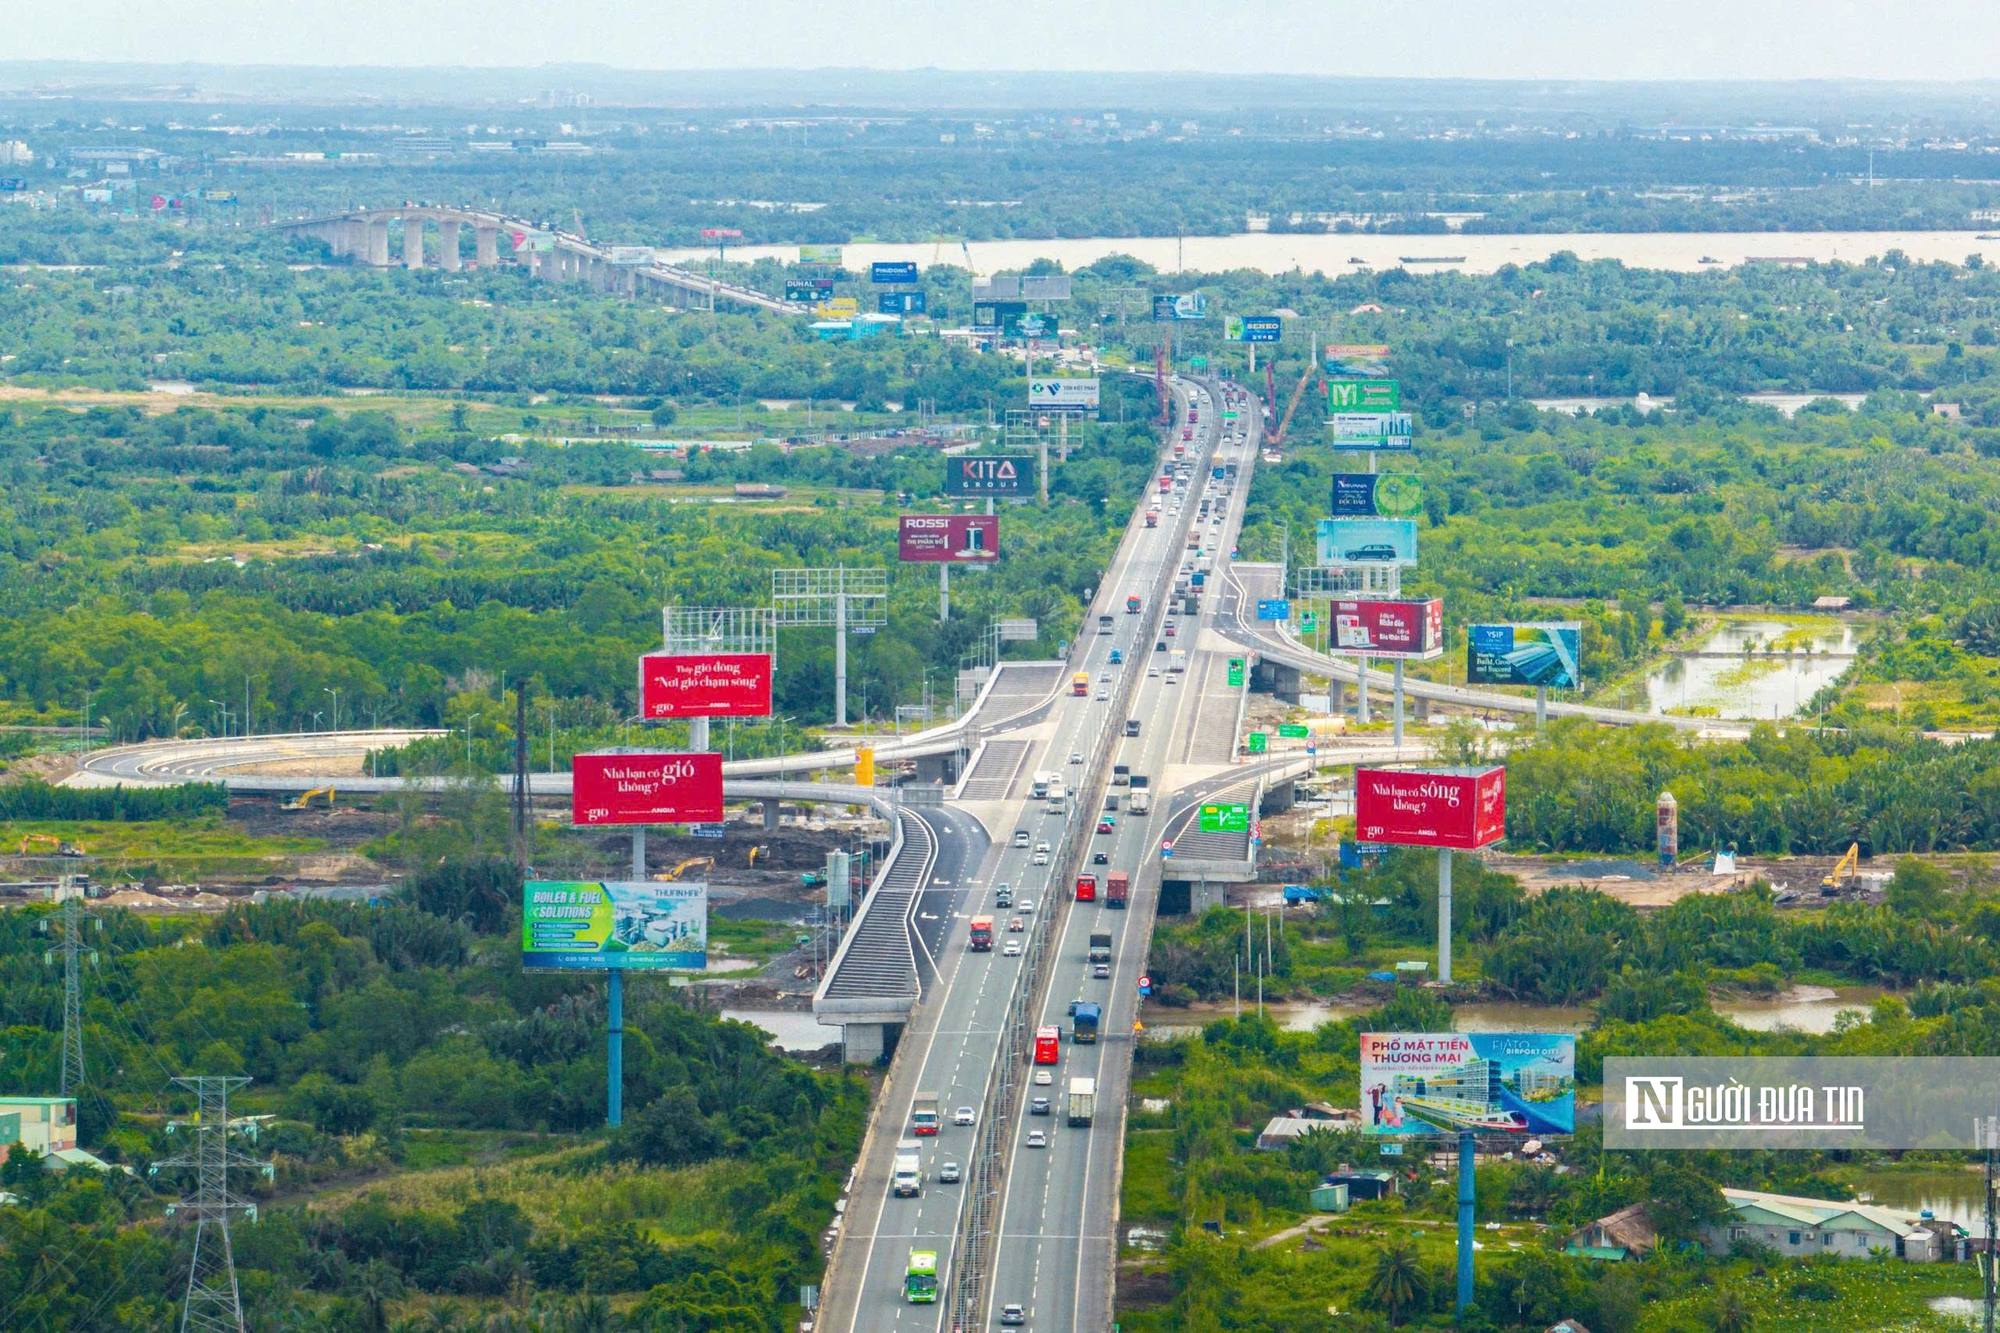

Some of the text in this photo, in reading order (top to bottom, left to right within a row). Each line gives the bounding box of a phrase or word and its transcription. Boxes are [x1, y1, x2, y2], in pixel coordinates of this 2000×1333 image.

[787, 280, 815, 288] DUHAL
[963, 460, 1017, 479] KITA
[906, 519, 949, 528] ROSSI
[944, 534, 949, 549] 1
[700, 675, 729, 688] chạm
[603, 760, 695, 786] Nhà bạn có gió
[1372, 780, 1460, 808] Nhà bạn có sông
[534, 891, 602, 904] BOILER & FUEL
[539, 906, 593, 919] SOLUTIONS
[1372, 1037, 1469, 1052] PHỐ MẶT TIỀN
[1372, 1053, 1461, 1064] THƯƠNG MẠI
